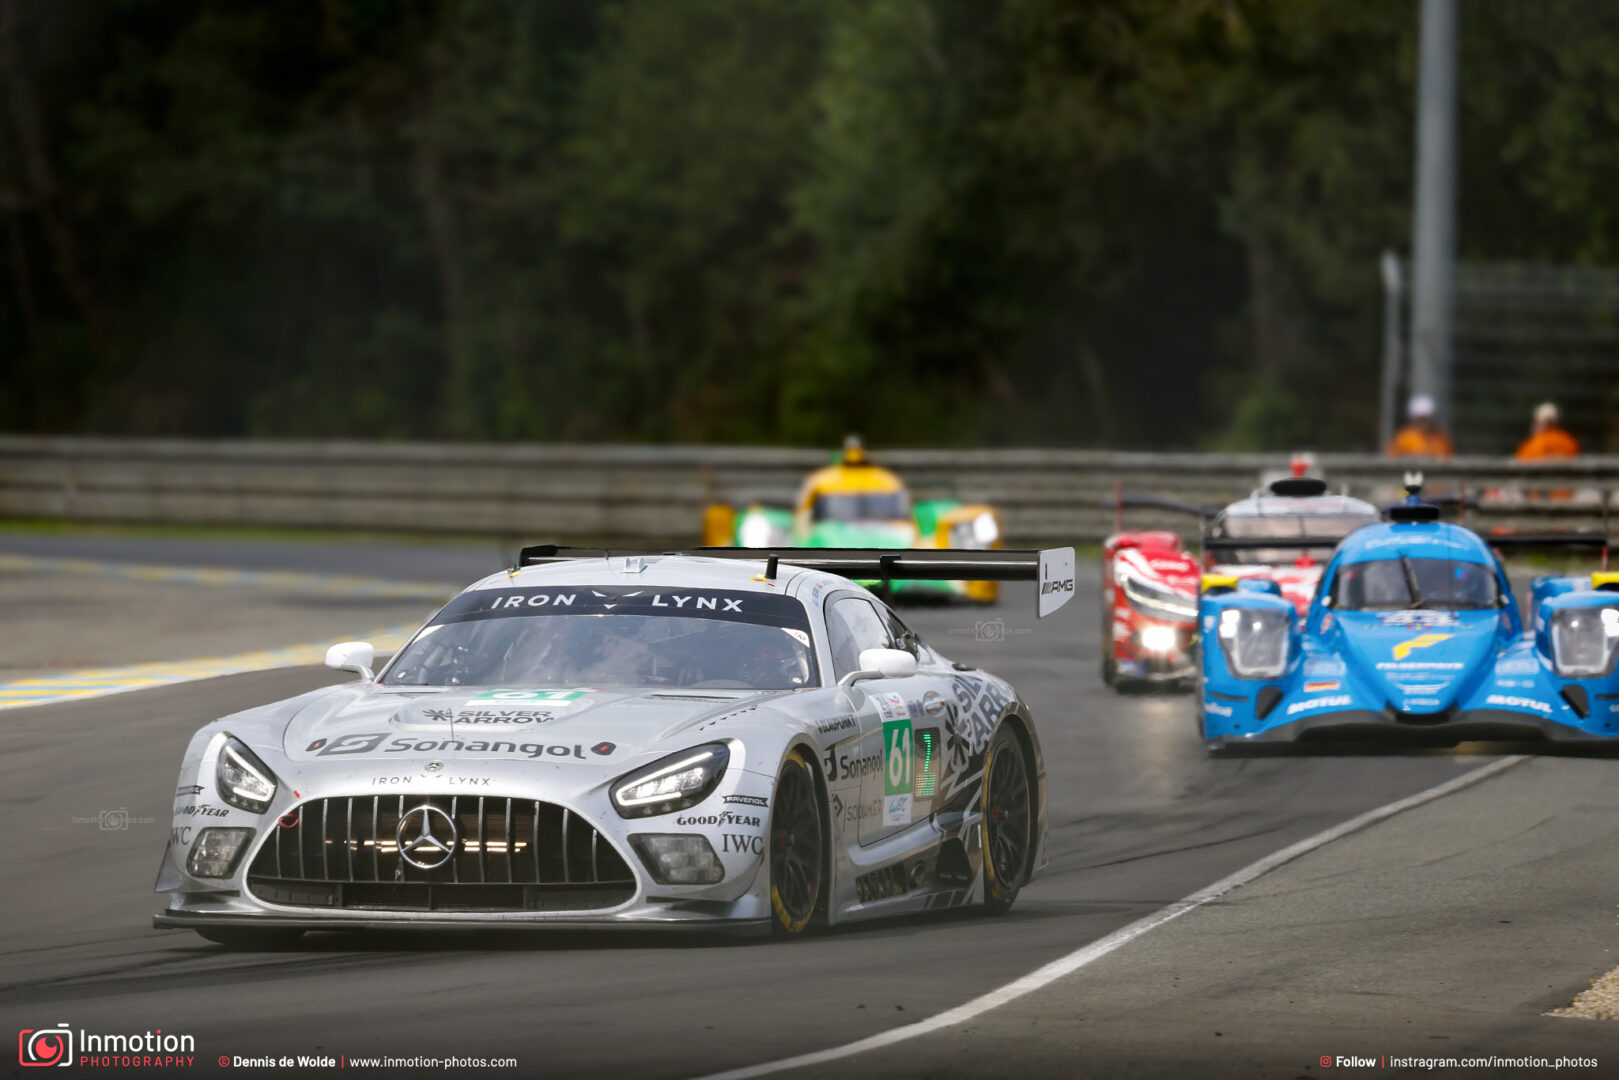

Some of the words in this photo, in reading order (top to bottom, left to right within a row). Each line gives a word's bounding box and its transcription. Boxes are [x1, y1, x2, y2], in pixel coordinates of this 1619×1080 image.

[491, 594, 577, 610] IRON
[652, 595, 744, 613] LYNX
[458, 710, 553, 718] SILVER
[384, 738, 587, 760] Sonangol
[889, 727, 911, 787] 61
[840, 749, 884, 782] Sonangol
[372, 776, 412, 786] IRON
[449, 777, 491, 786] LYNX
[722, 833, 764, 856] IWC
